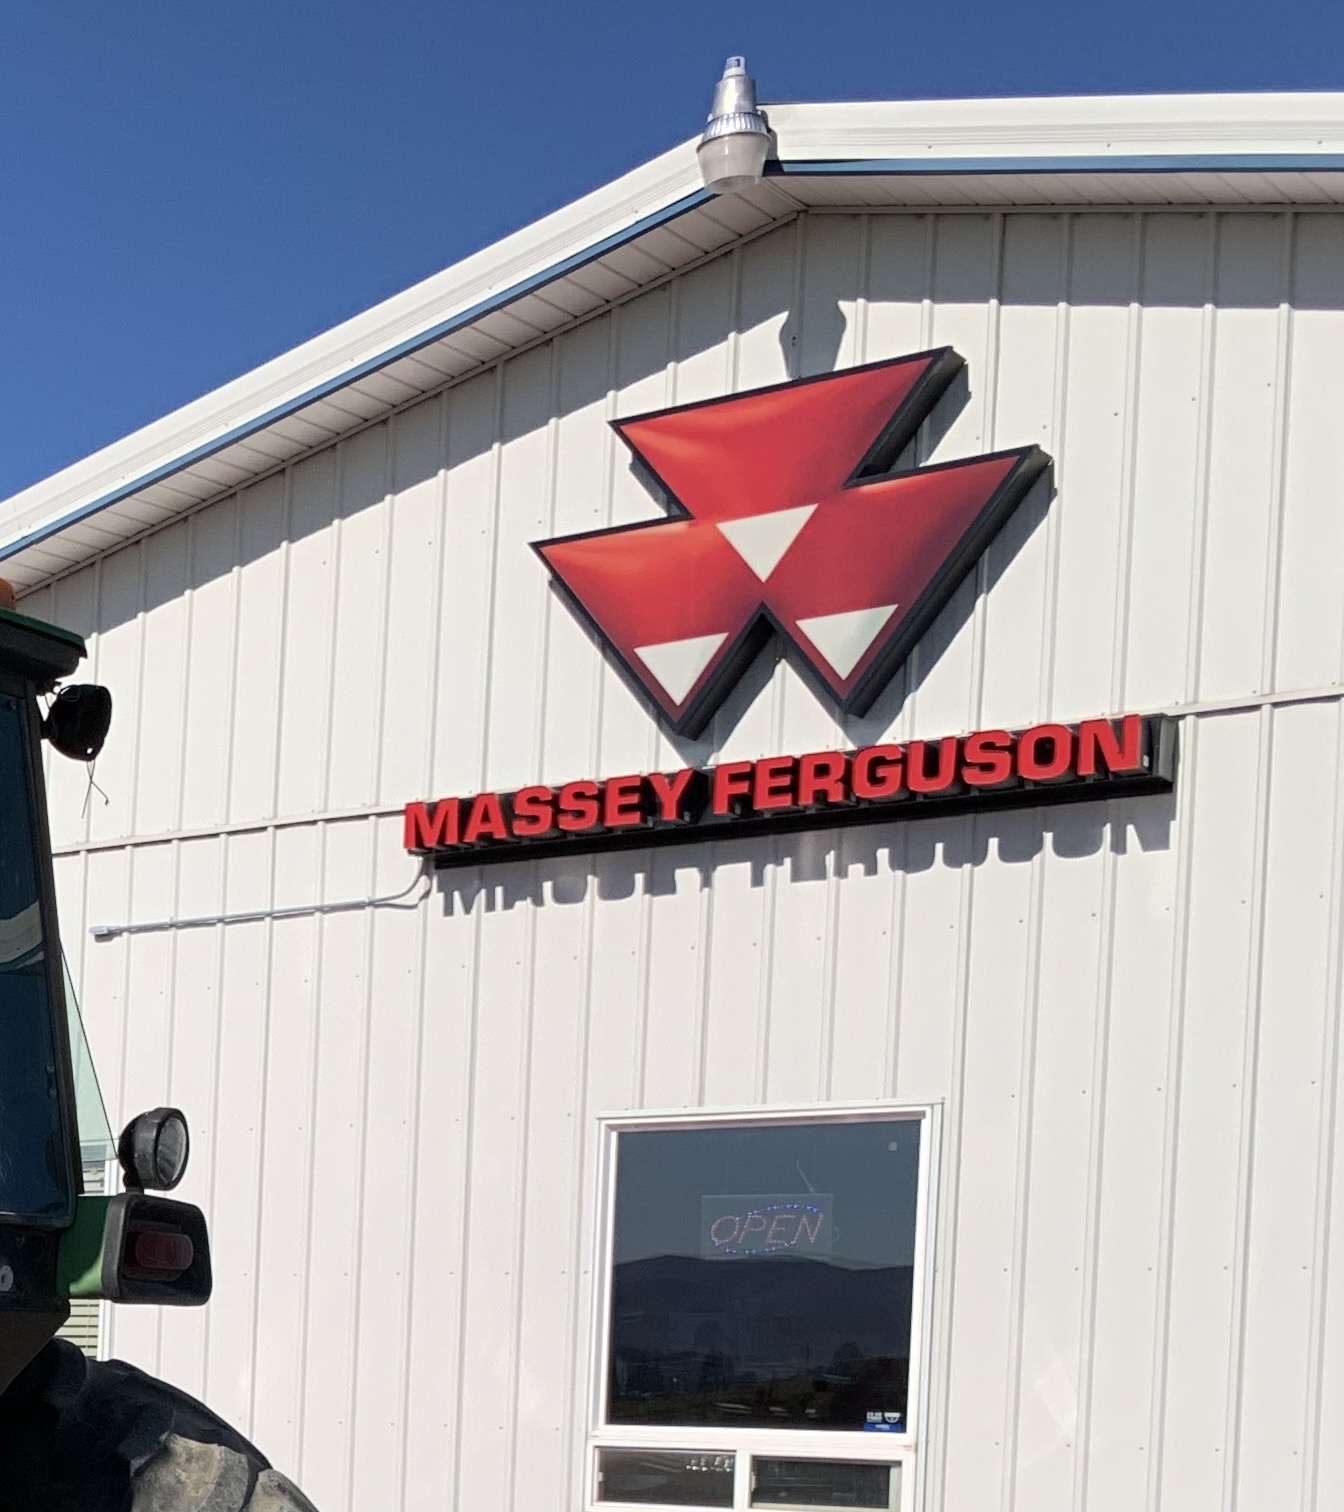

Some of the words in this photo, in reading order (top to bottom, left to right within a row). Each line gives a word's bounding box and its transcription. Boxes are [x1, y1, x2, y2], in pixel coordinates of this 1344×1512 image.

[403, 767, 697, 850] MASSEY
[712, 713, 1142, 815] FERGUSON
[711, 1212, 824, 1246] OPEN
